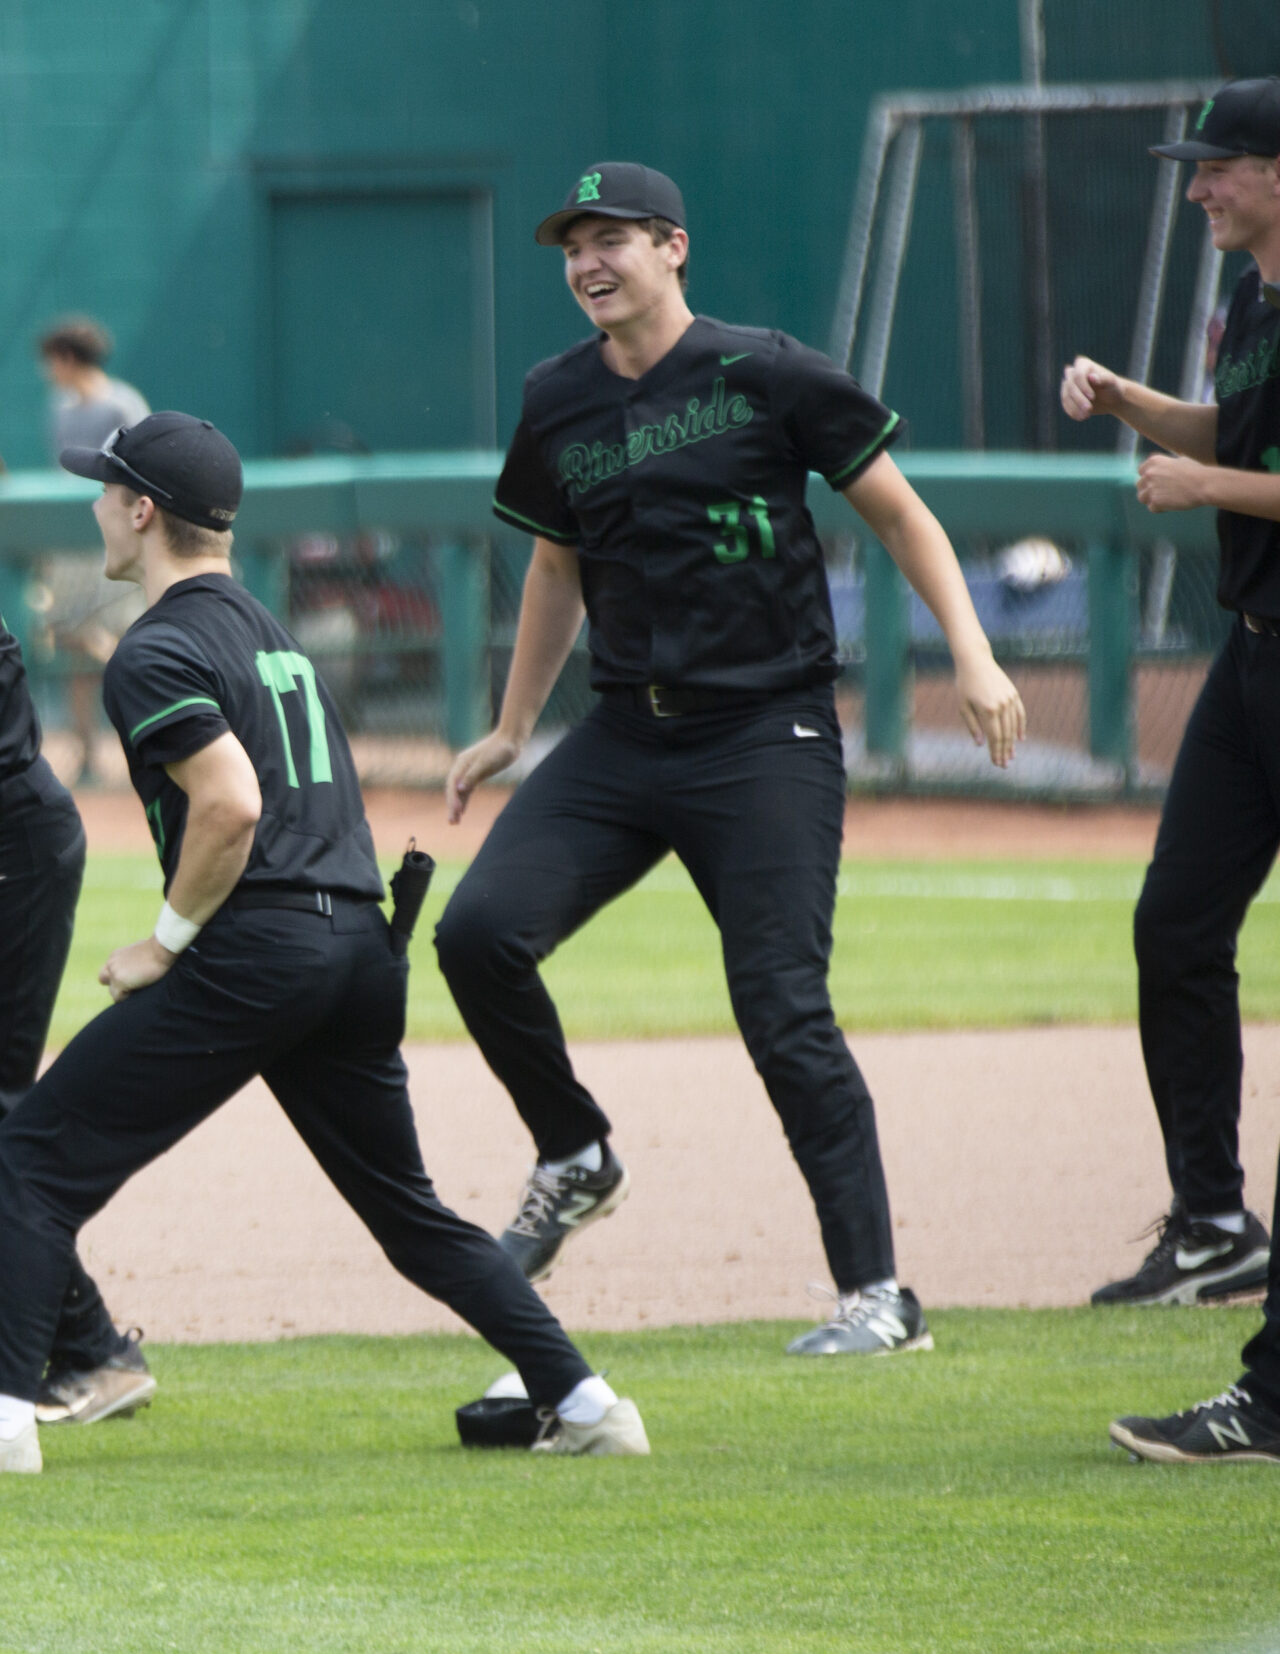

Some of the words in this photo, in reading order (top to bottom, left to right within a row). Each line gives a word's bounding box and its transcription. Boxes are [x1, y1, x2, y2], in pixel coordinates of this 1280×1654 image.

[576, 171, 602, 204] R
[557, 376, 754, 494] Riverside
[706, 494, 776, 564] 31
[255, 650, 333, 789] 17
